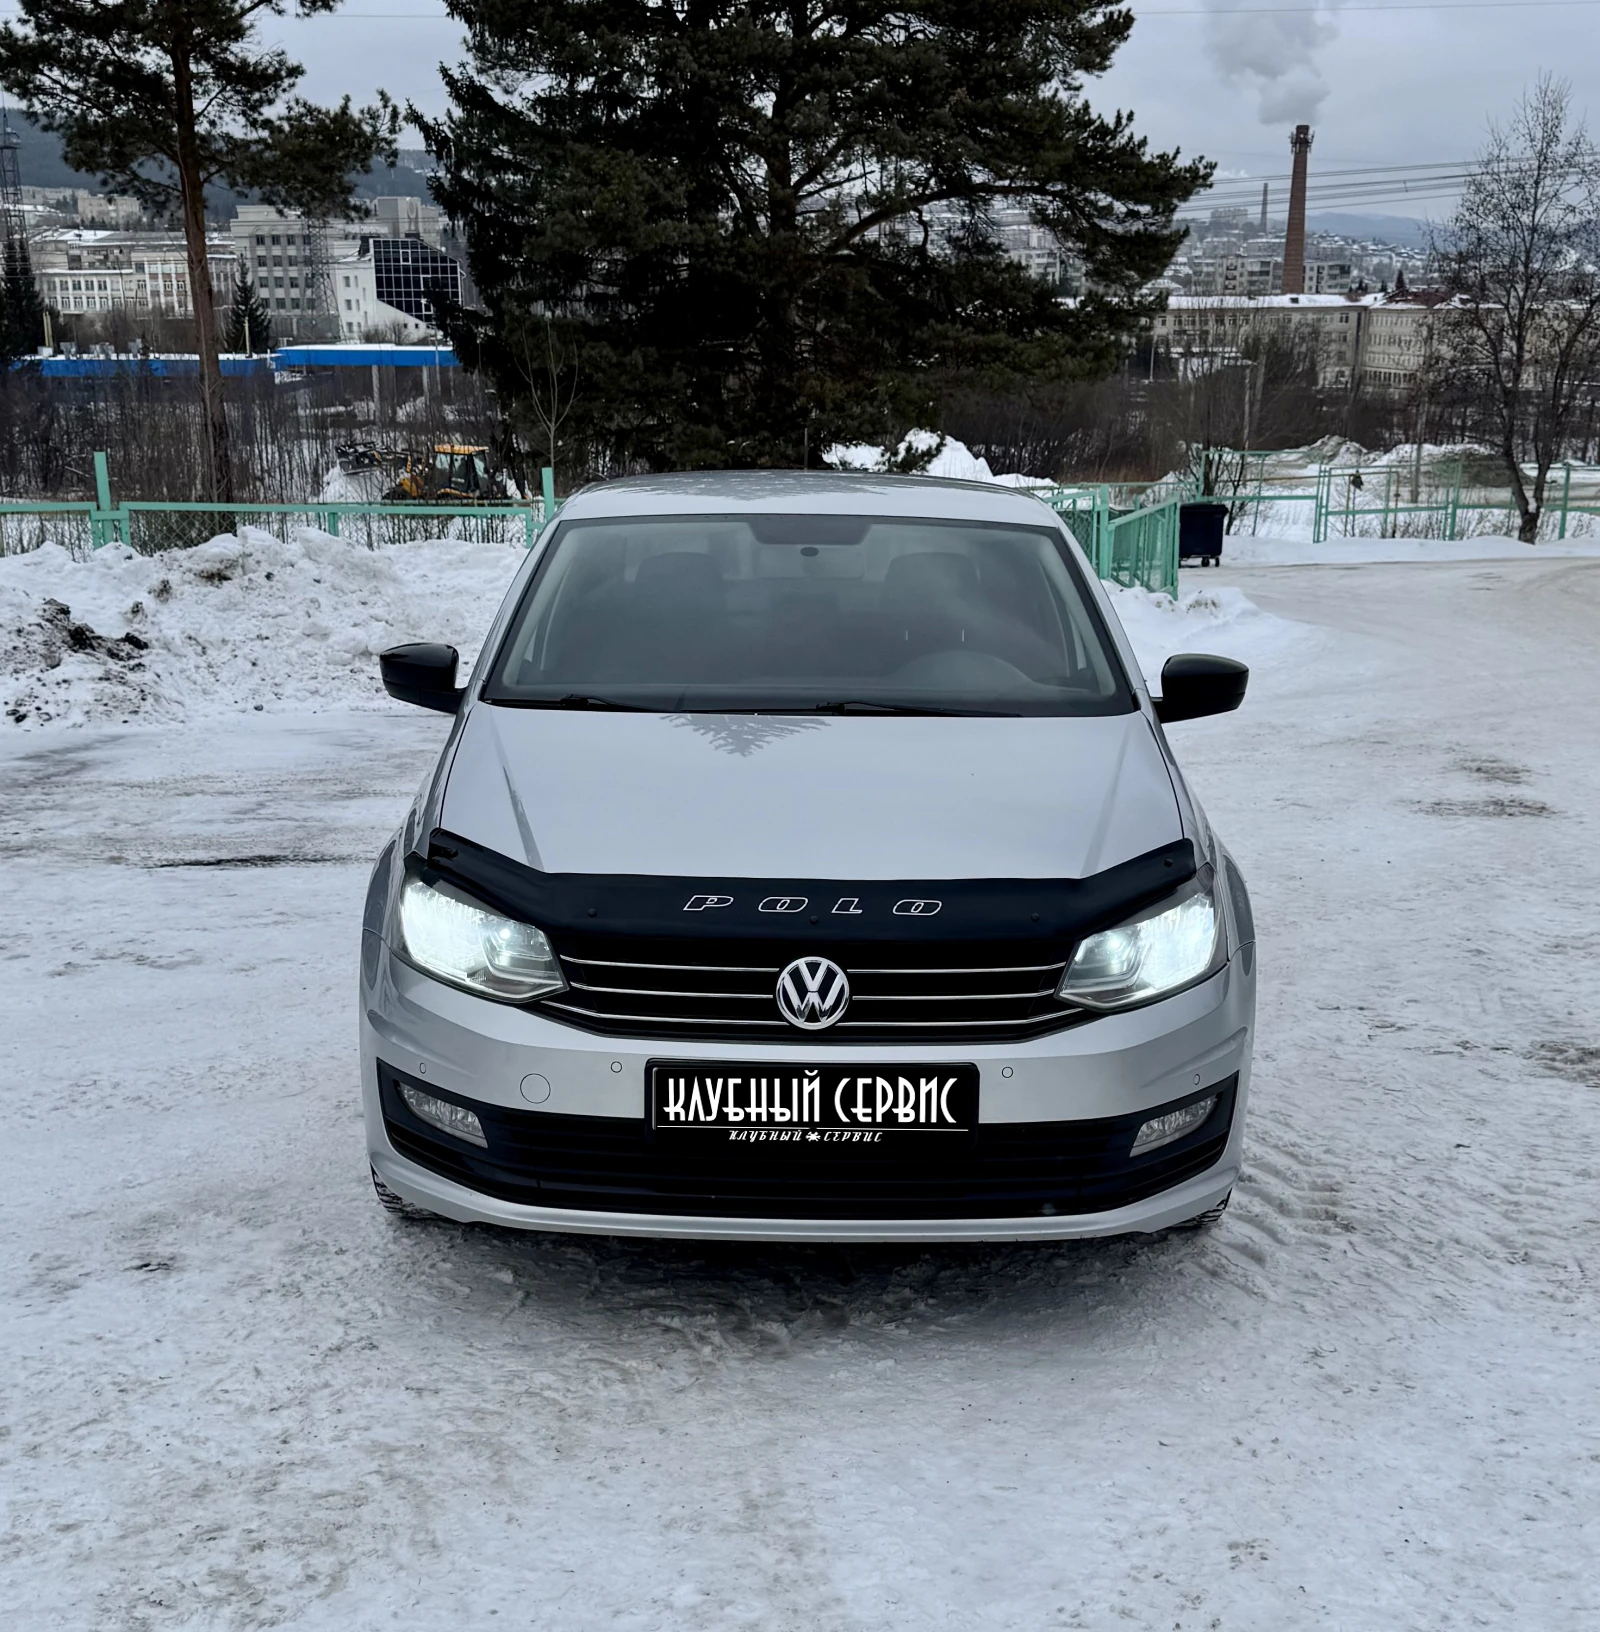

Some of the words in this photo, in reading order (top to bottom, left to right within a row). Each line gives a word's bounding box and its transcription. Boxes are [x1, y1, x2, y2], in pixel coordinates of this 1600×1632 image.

[682, 894, 943, 916] POLO
[780, 958, 846, 1026] VW
[663, 1069, 821, 1123] КЛУБНЫЙ
[833, 1075, 959, 1124] СЕРВИС
[728, 1128, 803, 1143] КЛУБНЫЙ
[822, 1130, 884, 1143] СЕРВИС
